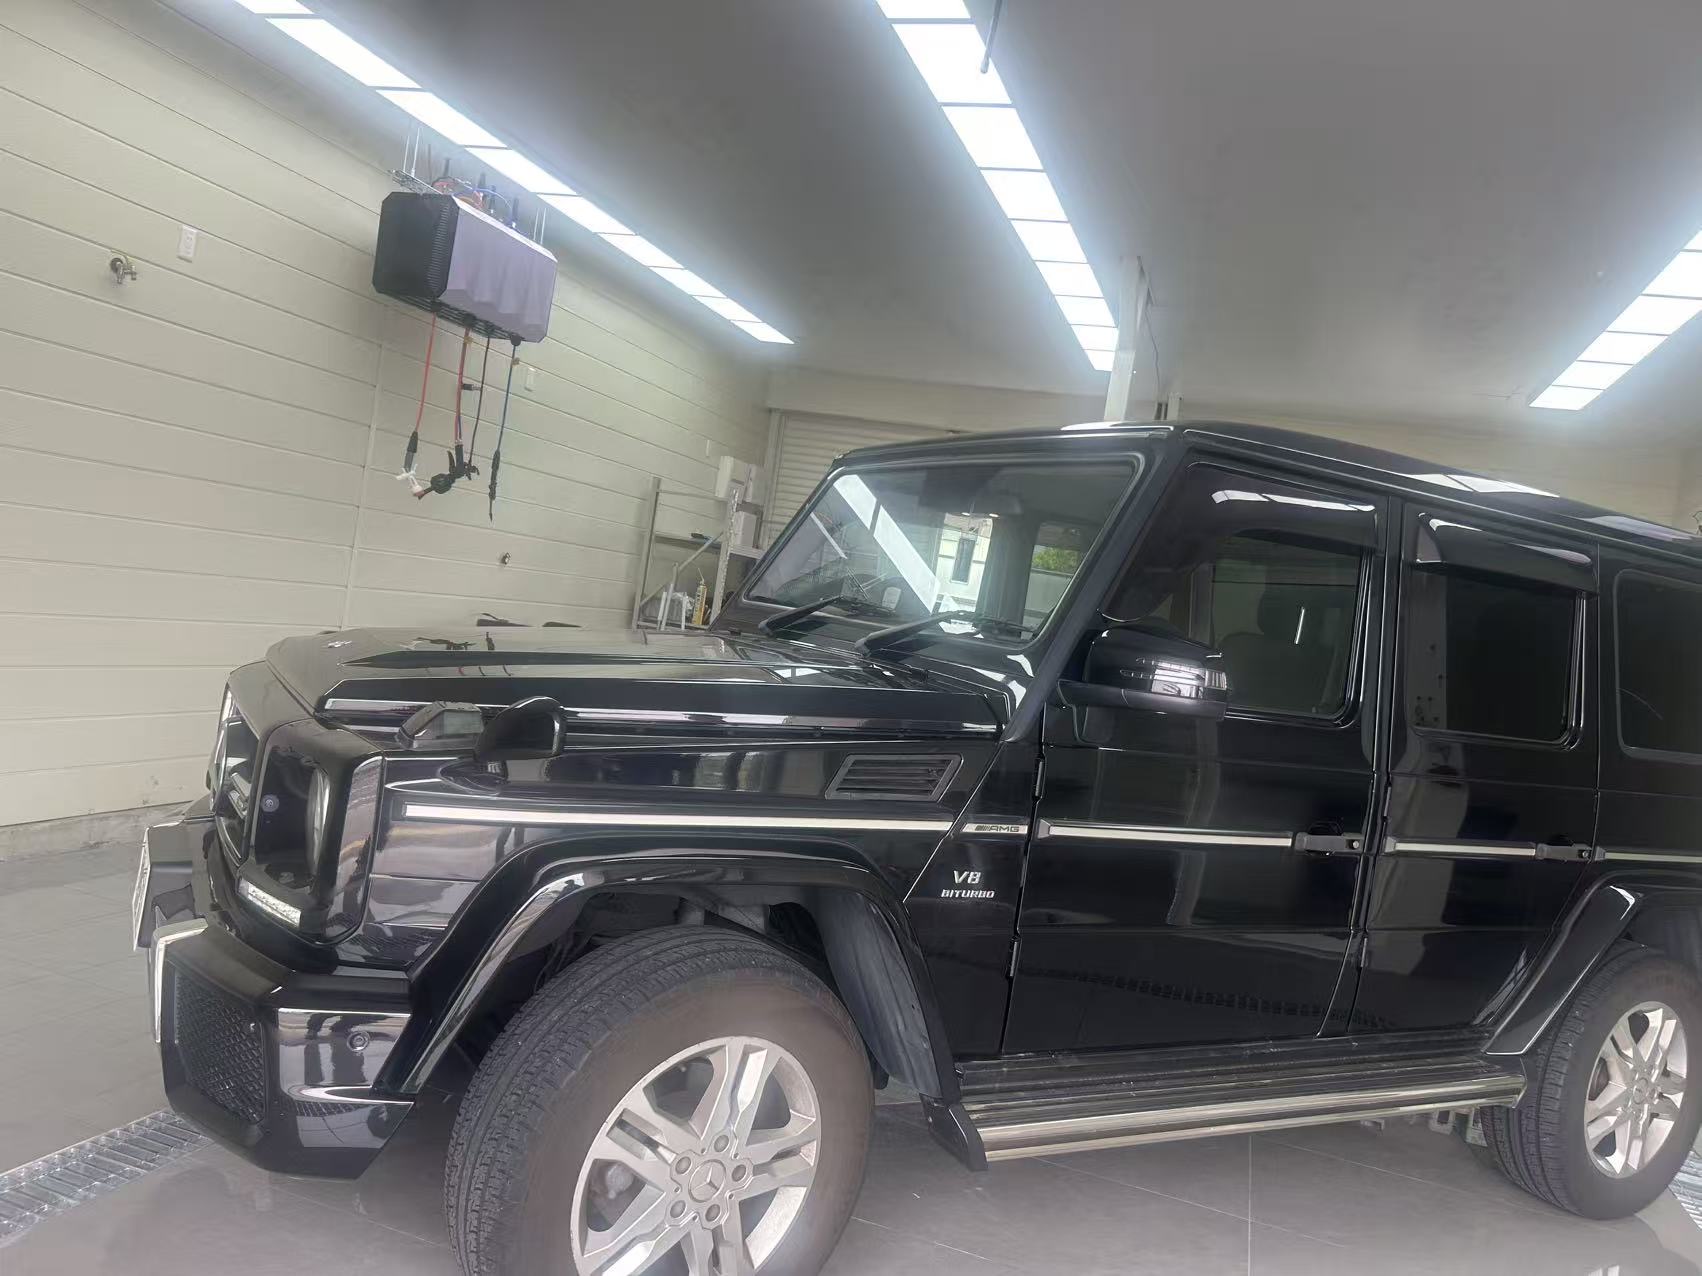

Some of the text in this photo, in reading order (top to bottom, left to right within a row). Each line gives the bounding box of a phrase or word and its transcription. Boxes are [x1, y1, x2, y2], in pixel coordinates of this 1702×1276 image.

[988, 825, 1020, 833] AMG
[953, 870, 981, 885] V8
[941, 889, 995, 899] BITURBO
